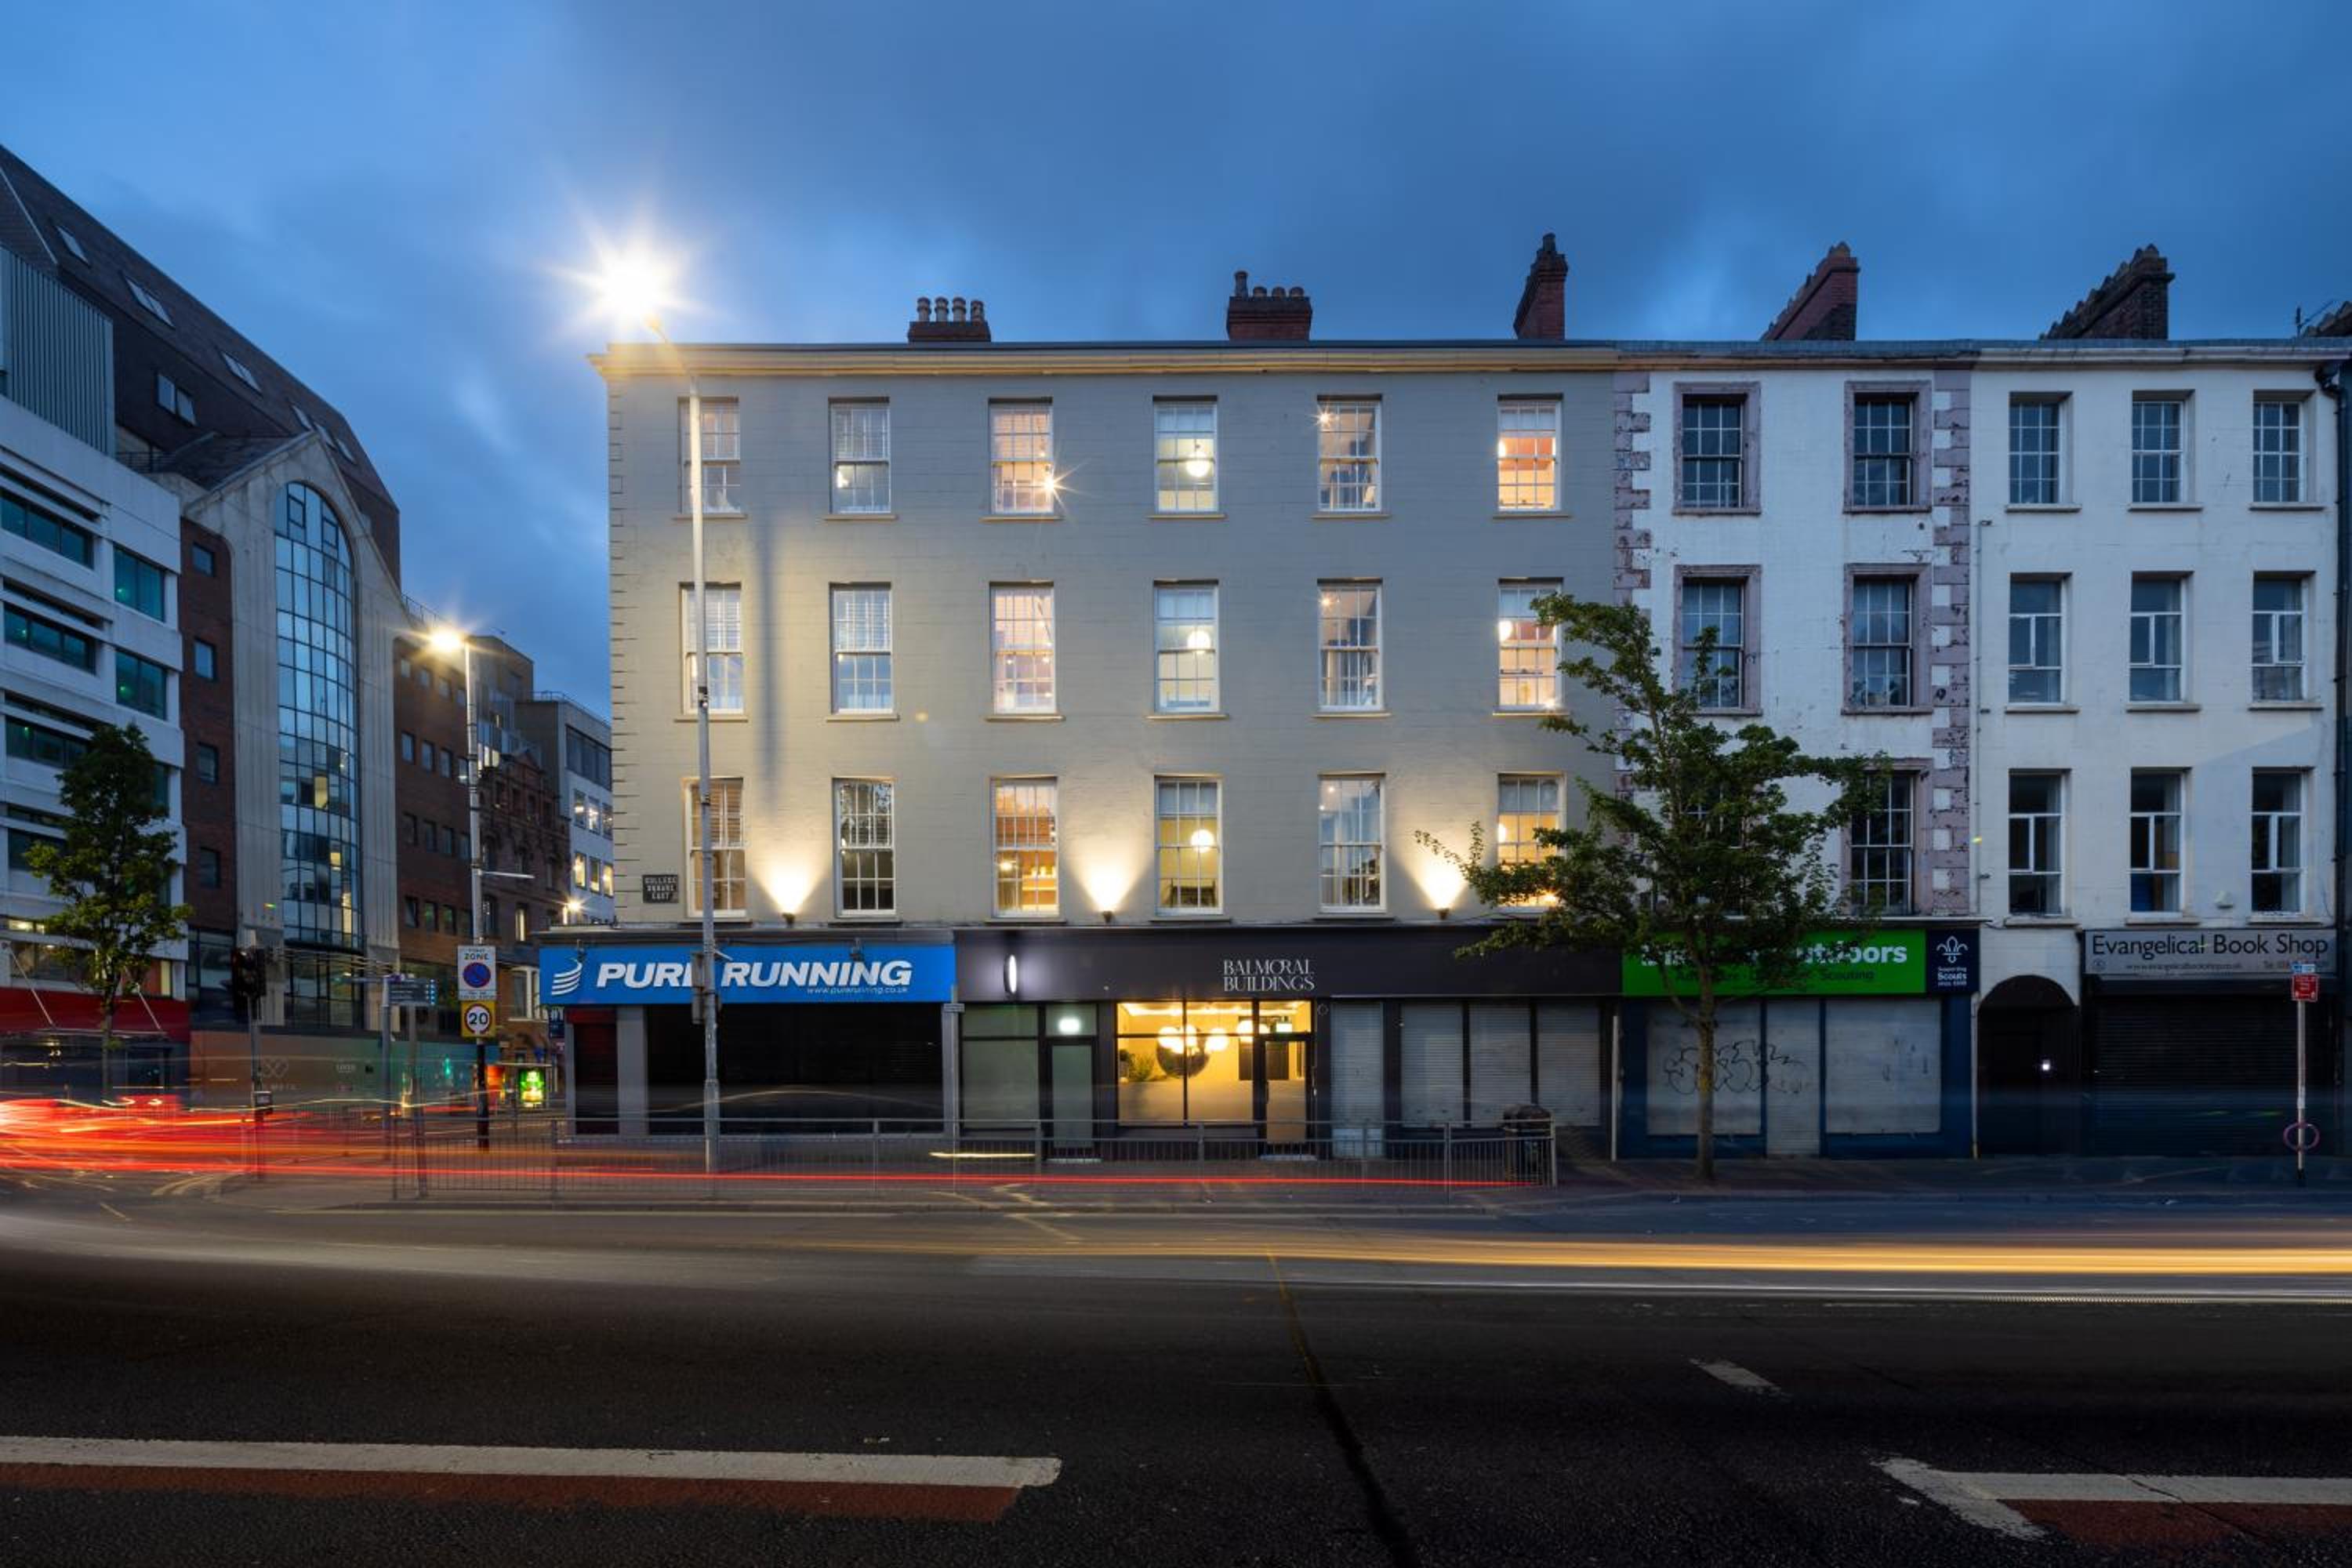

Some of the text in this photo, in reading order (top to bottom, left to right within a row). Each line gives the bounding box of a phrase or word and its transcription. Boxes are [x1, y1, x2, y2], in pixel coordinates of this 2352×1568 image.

[1781, 940, 1907, 964] utdoors
[2092, 935, 2328, 960] Evangelical Book Shop
[720, 961, 913, 988] RUNNING
[1224, 959, 1315, 975] BALMORAL
[1224, 976, 1316, 992] BUILDINGS
[469, 1012, 488, 1025] 20
